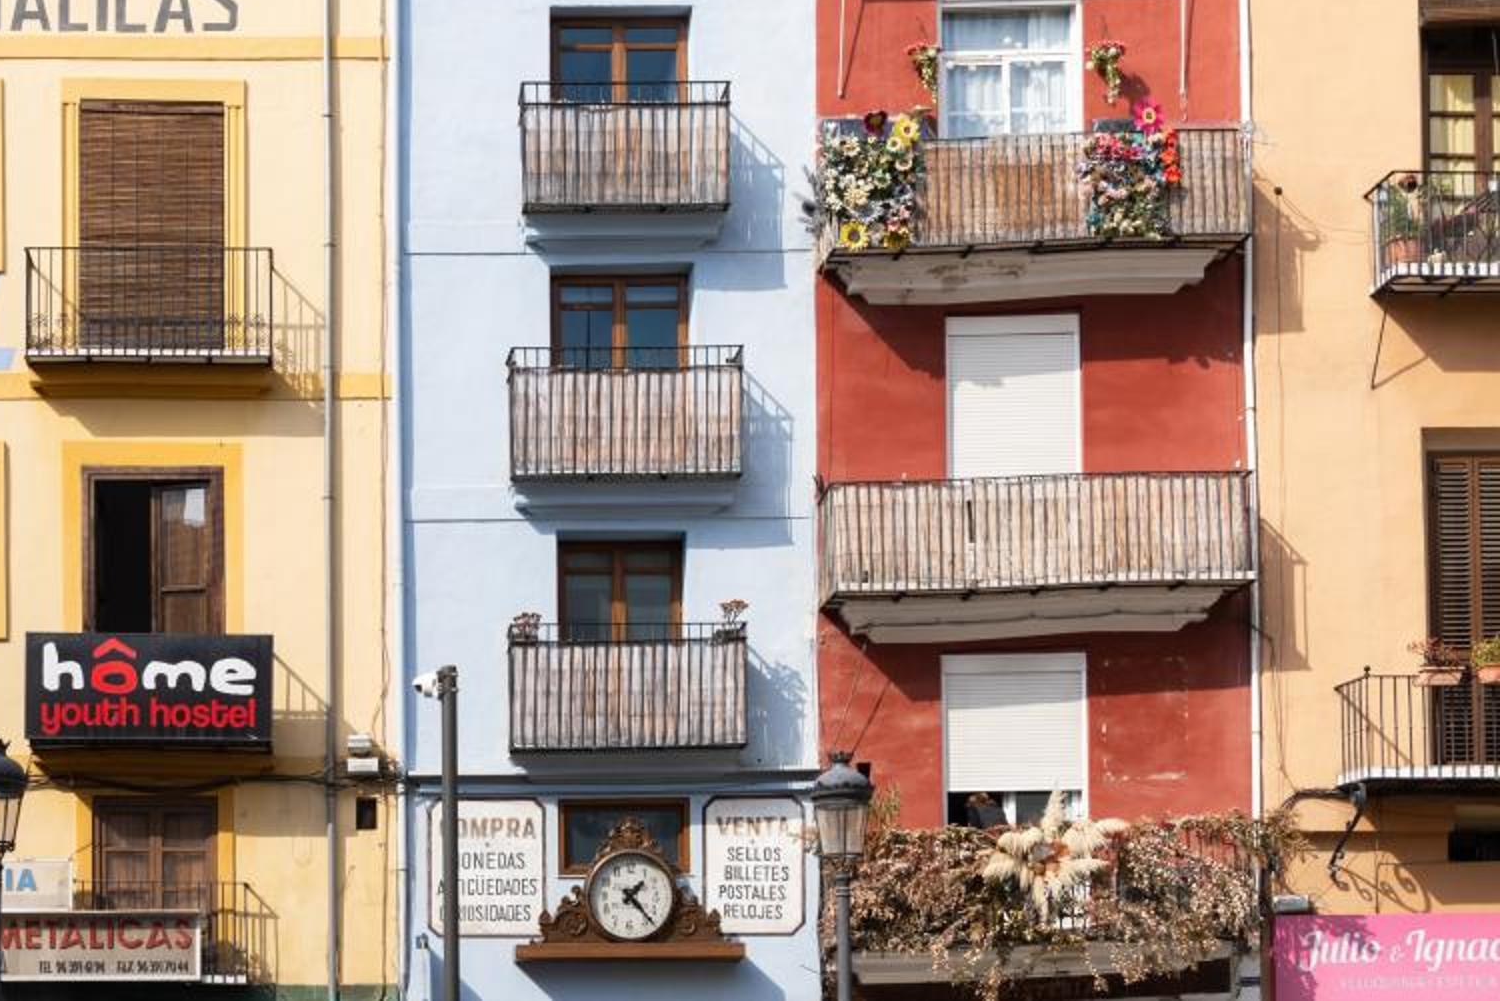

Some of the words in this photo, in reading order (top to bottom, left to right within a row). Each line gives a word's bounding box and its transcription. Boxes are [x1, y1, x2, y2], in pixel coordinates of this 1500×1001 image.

[40, 696, 139, 735] youth
[149, 697, 257, 728] hostel
[440, 817, 536, 839] OMPRA
[460, 852, 525, 870] ONEDAS
[727, 846, 782, 862] SELLOS
[724, 865, 790, 881] BILLETES
[718, 885, 787, 901] POSTALES
[723, 904, 783, 920] RELOJES
[1298, 930, 1381, 972] Julio
